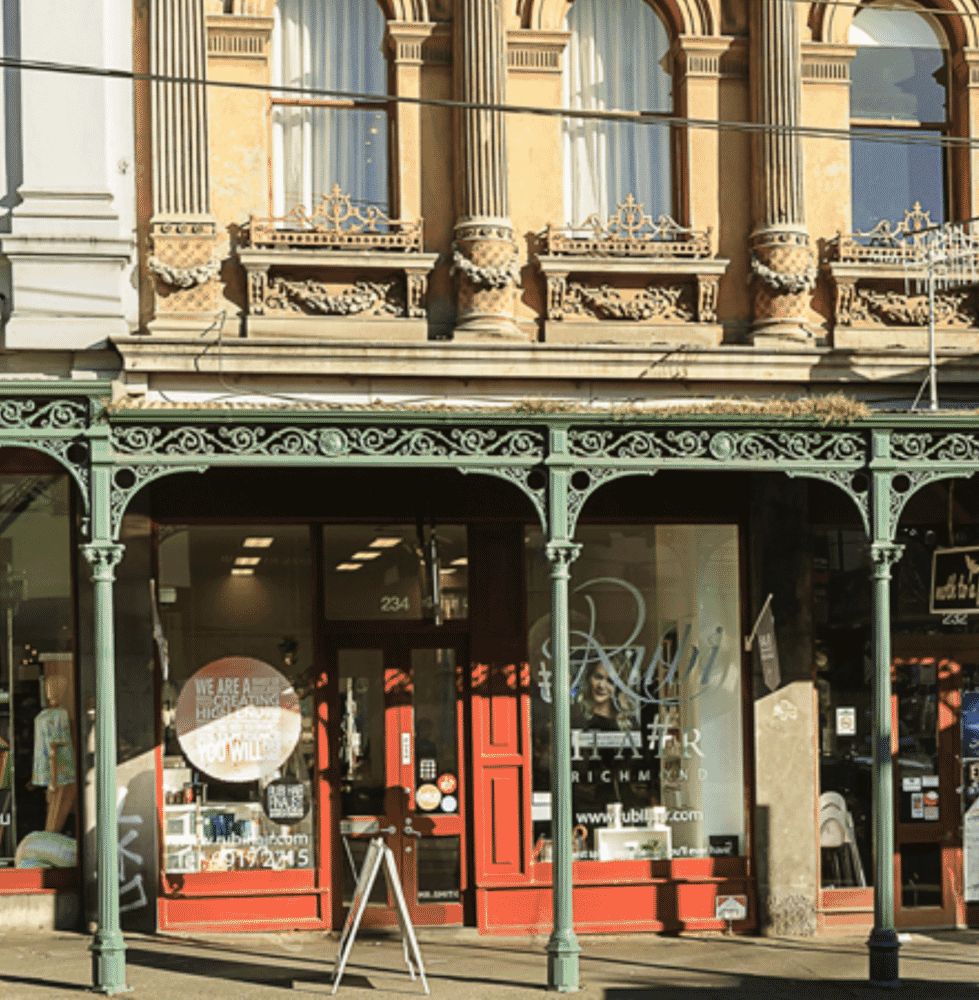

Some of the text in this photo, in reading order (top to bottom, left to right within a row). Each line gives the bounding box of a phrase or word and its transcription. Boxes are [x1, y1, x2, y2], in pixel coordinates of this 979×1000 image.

[381, 596, 409, 612] 234
[194, 677, 214, 694] WE
[217, 677, 240, 694] ARE
[242, 677, 250, 694] A
[571, 769, 708, 783] RICHMOND
[575, 808, 703, 824] www.ubir.com
